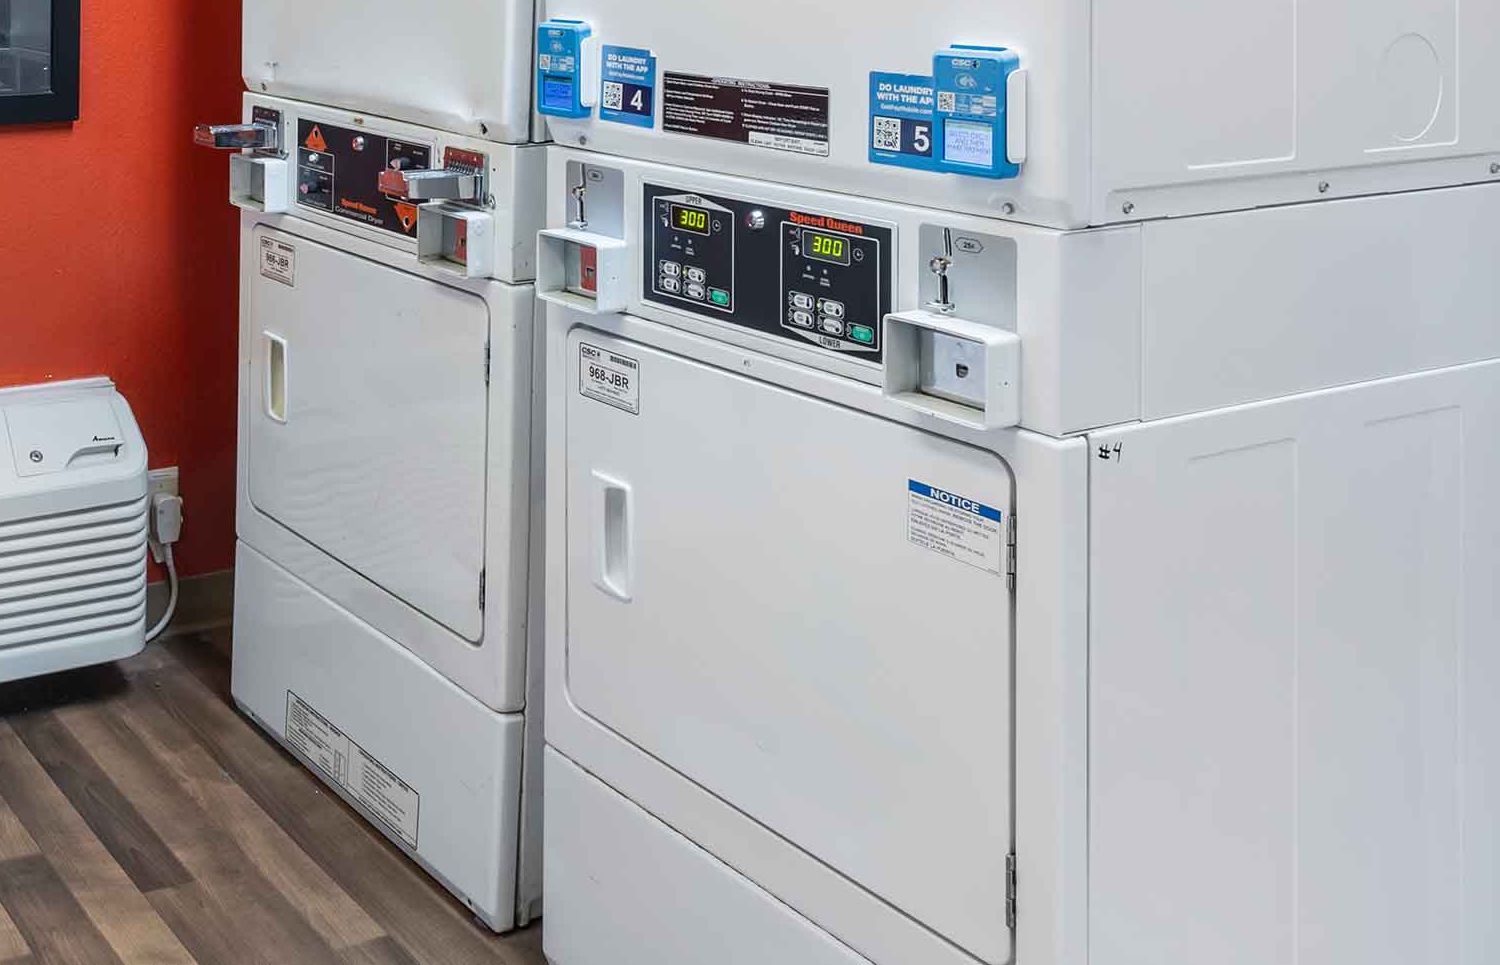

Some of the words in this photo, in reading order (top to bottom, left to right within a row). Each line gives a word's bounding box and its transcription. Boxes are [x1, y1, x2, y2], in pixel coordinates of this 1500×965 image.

[877, 91, 899, 101] WITH
[901, 94, 918, 103] THE
[879, 83, 892, 91] DO
[630, 89, 643, 111] 4
[913, 125, 930, 152] 5
[685, 196, 702, 205] UPPER
[680, 210, 705, 229] 300
[789, 211, 825, 227] Speed
[826, 219, 863, 235] Queen
[813, 236, 843, 257] 300
[581, 346, 597, 357] CSC
[818, 336, 841, 349] LOWER
[589, 365, 629, 389] 968-JBR
[1098, 442, 1122, 464] #4
[929, 488, 981, 514] NOTICE
